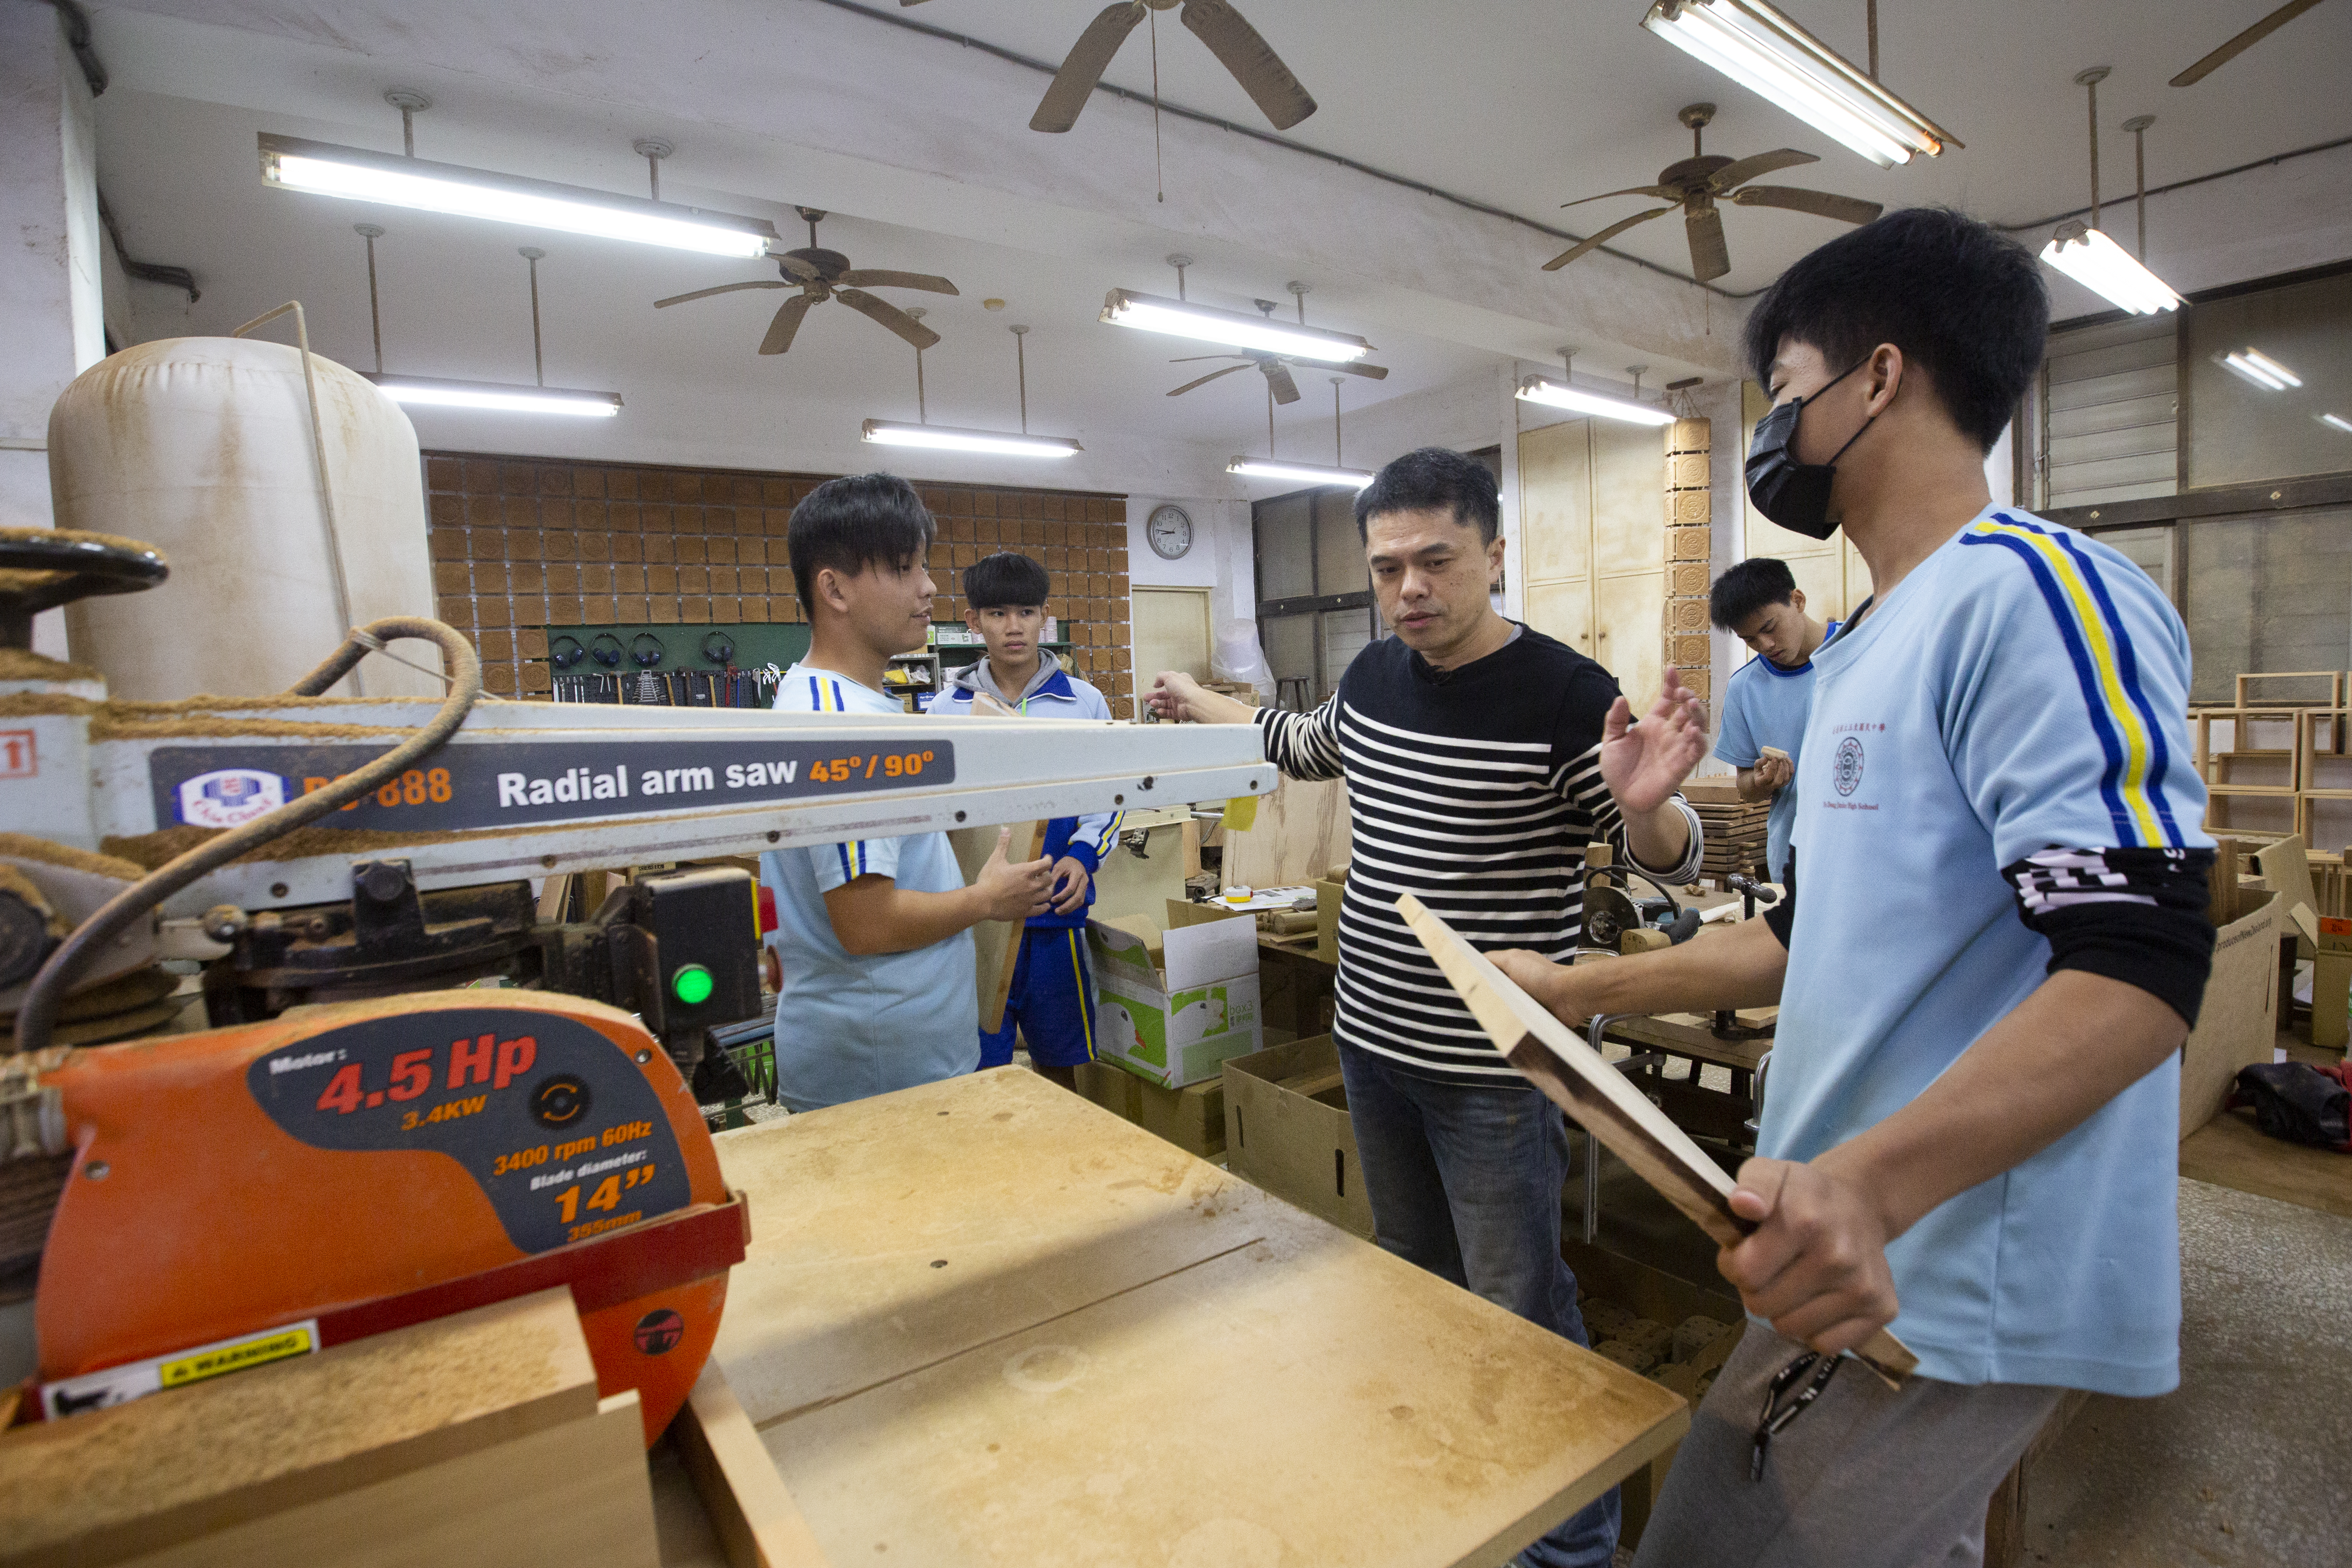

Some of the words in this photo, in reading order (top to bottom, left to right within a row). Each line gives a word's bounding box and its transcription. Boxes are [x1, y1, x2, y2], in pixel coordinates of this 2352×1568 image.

[497, 764, 628, 808] Radial
[641, 766, 714, 795] arm
[725, 760, 797, 788] saw
[270, 1049, 347, 1074] Motor:
[316, 1047, 433, 1115] 4.5
[447, 1033, 537, 1090] Hp
[401, 1094, 488, 1130] 3.4KW
[493, 1145, 549, 1176] 3400
[554, 1136, 597, 1162] rpm
[601, 1120, 653, 1147] 60Hz
[530, 1169, 575, 1191] Blade
[577, 1149, 648, 1178] diameter:
[567, 1210, 642, 1242] 355mm
